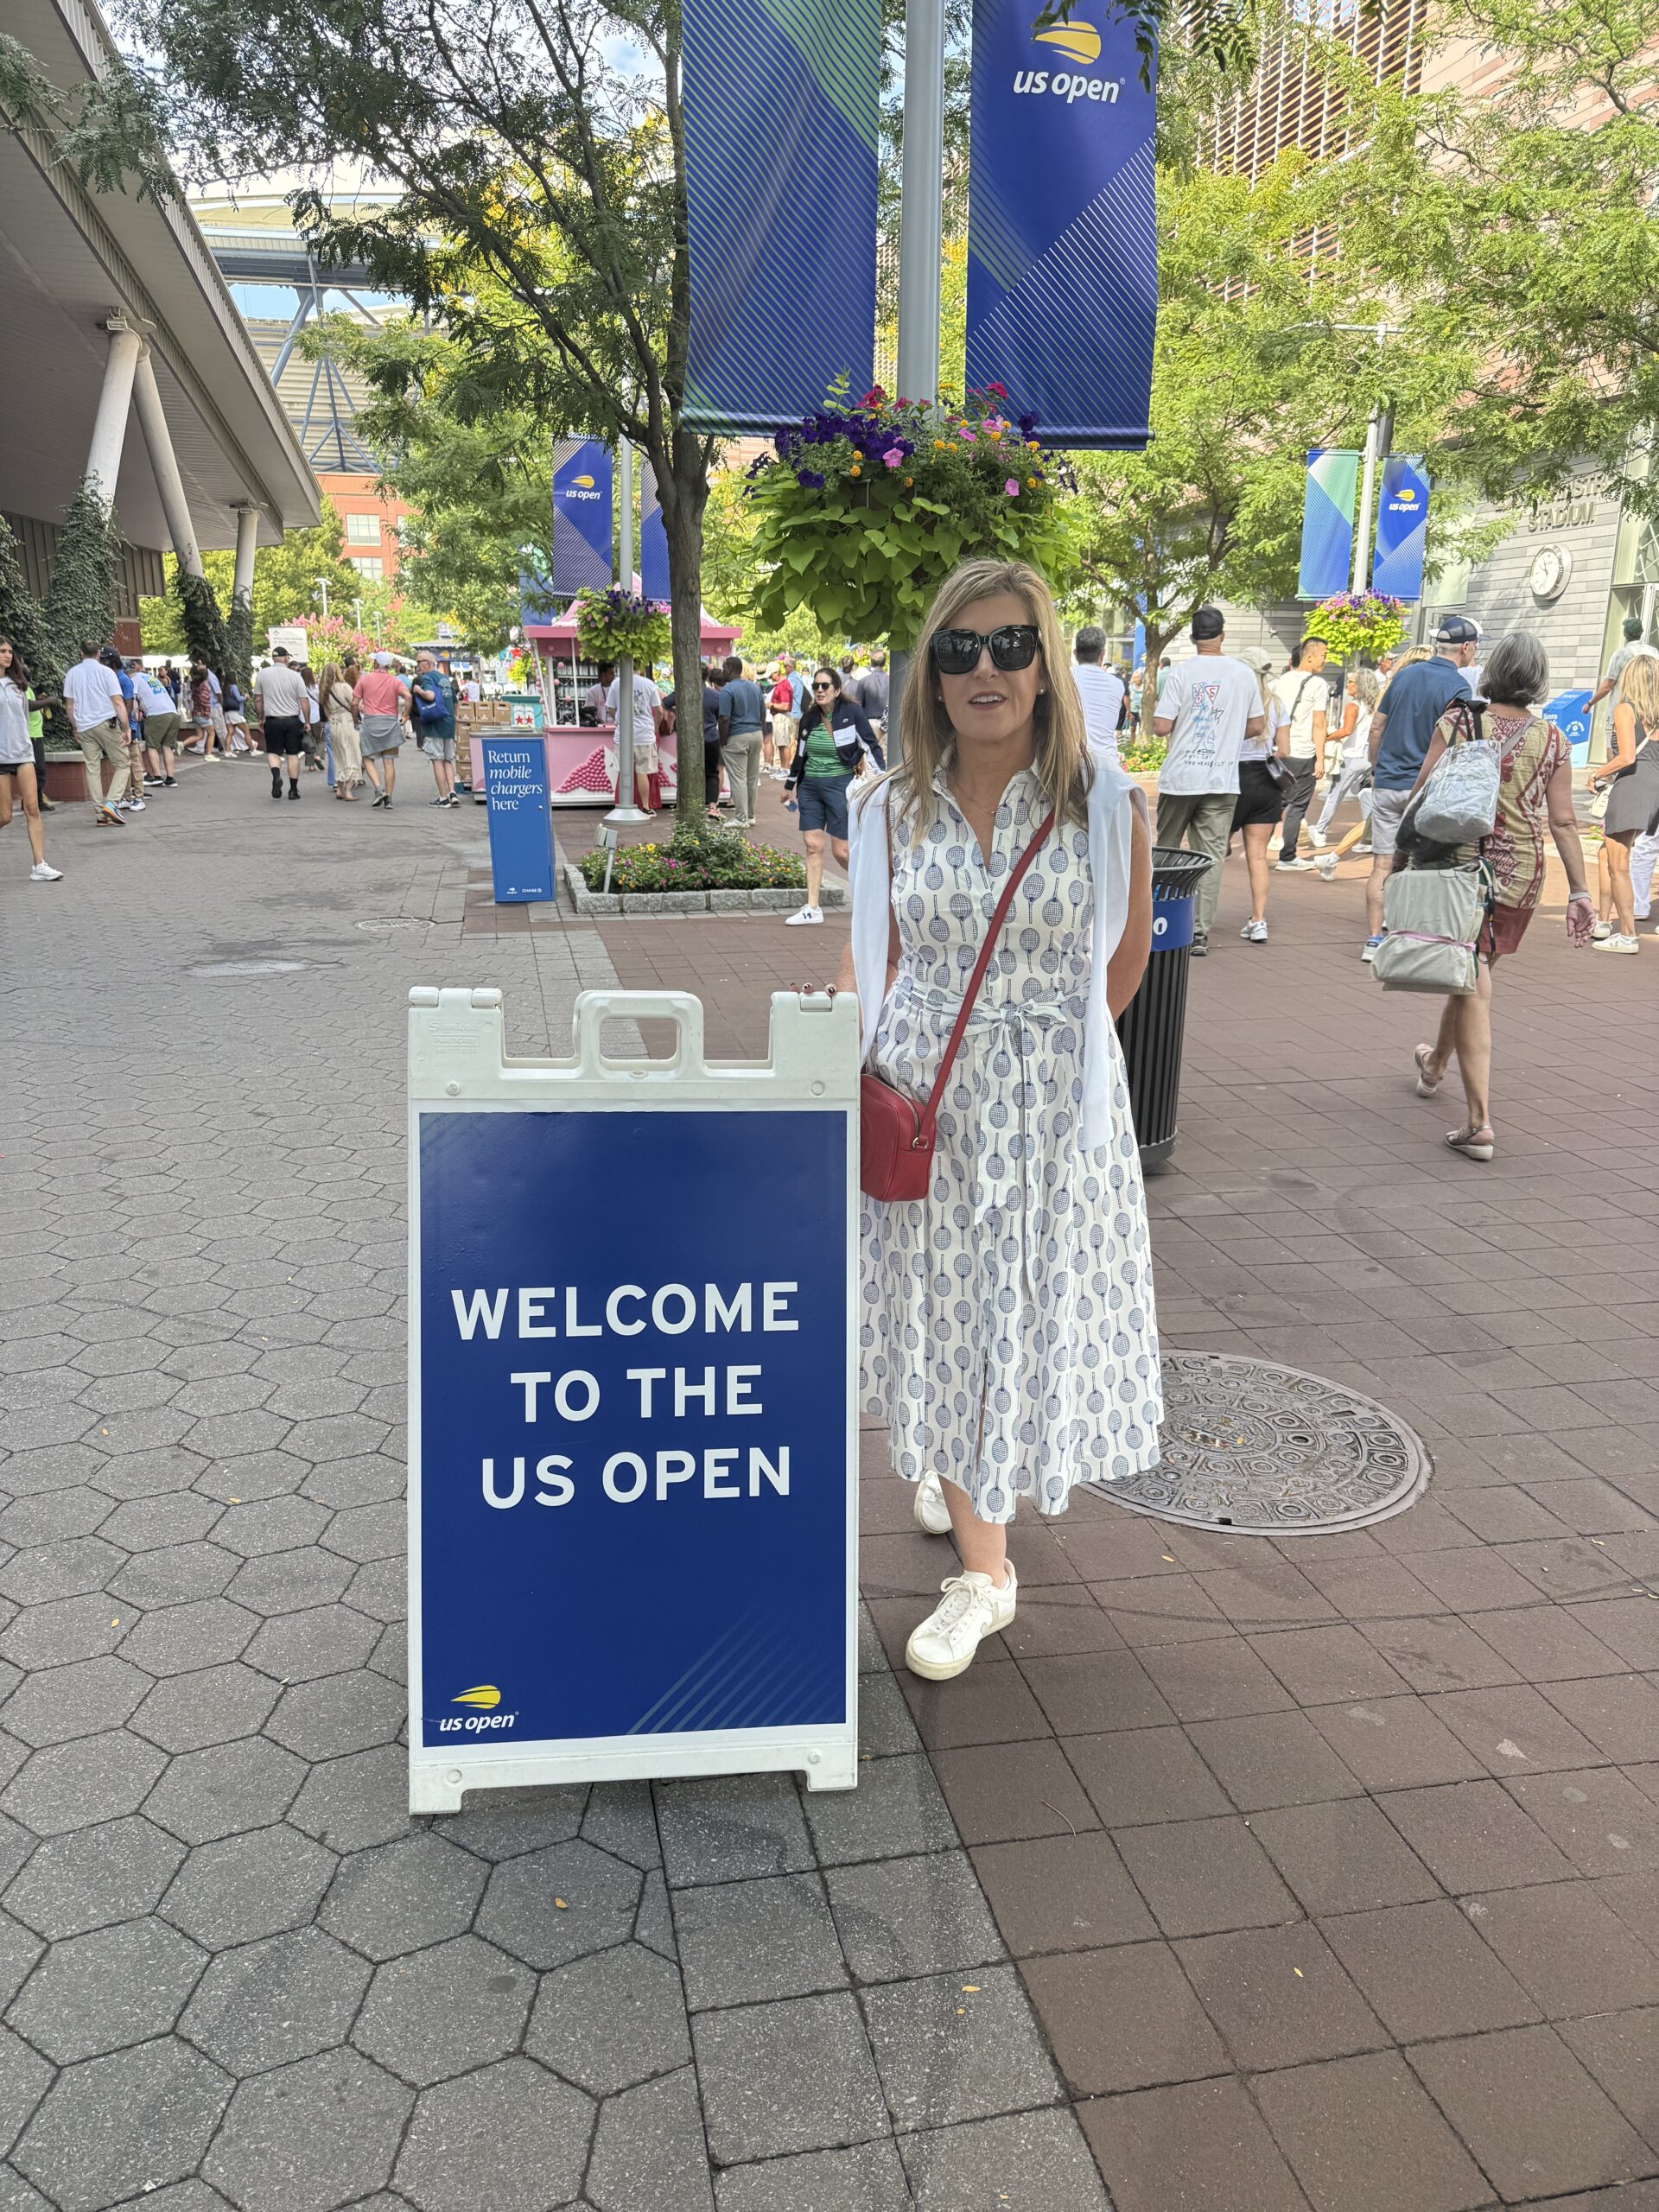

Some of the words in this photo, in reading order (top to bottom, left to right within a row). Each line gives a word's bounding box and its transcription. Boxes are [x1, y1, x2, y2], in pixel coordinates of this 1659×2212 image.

[1013, 71, 1049, 94] us
[1529, 501, 1594, 532] STADIUM
[488, 750, 531, 763] Return
[489, 765, 532, 779] mobile
[490, 781, 543, 798] chargers
[492, 797, 519, 810] here
[451, 1281, 800, 1340] WELCOME
[510, 1370, 601, 1423] TO
[626, 1364, 763, 1418] THE
[482, 1454, 575, 1510] US
[602, 1446, 790, 1503] OPEN
[439, 1718, 464, 1732] us
